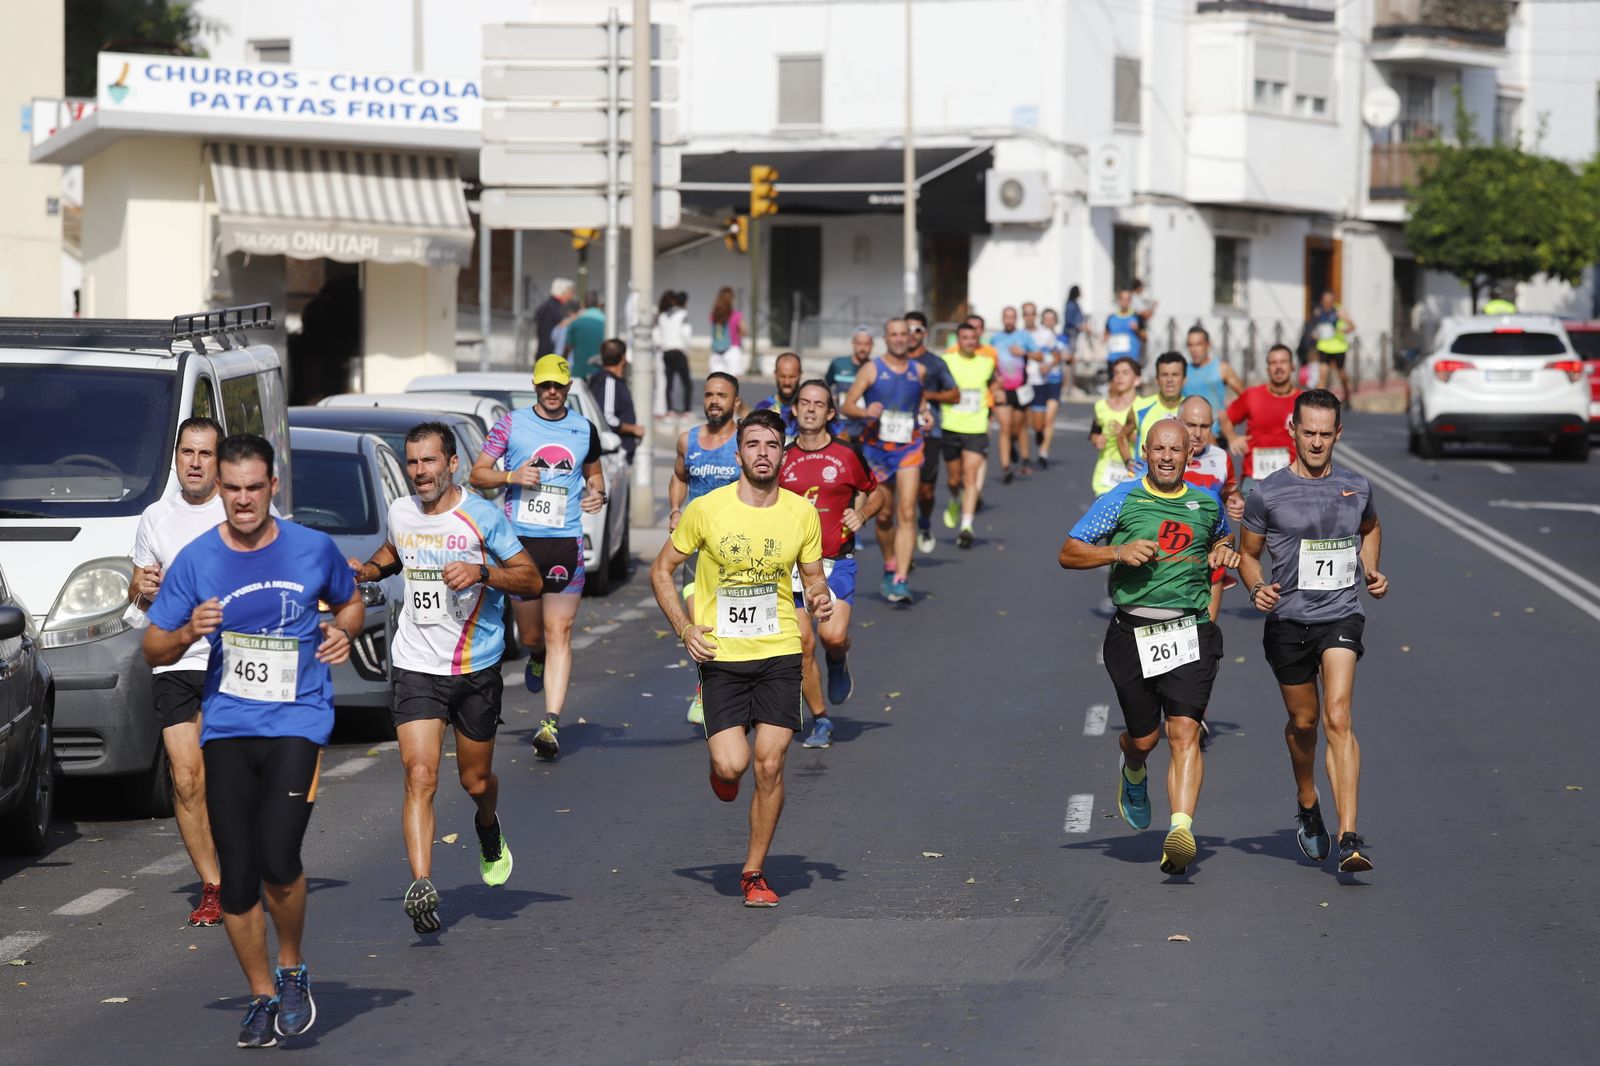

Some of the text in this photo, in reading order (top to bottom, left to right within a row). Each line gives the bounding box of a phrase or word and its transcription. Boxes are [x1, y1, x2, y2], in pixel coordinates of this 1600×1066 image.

[145, 63, 299, 89] CHURROS
[189, 91, 460, 123] PATATAS FRITAS
[292, 230, 380, 256] ONUTAPI
[528, 498, 551, 514] 658
[397, 532, 467, 550] HAPPY GO
[764, 538, 775, 548] 30
[1312, 542, 1331, 550] VUELTA
[1332, 541, 1337, 549] A
[1315, 560, 1333, 576] 71
[413, 591, 440, 609] 651
[728, 589, 747, 597] VUELTA
[748, 588, 754, 596] A
[754, 586, 774, 595] HUELVA
[729, 606, 757, 624] 547
[235, 637, 260, 649] VUELTA
[260, 639, 267, 649] A
[267, 640, 294, 650] HUELVA
[1150, 641, 1178, 662] 261
[234, 660, 268, 683] 463
